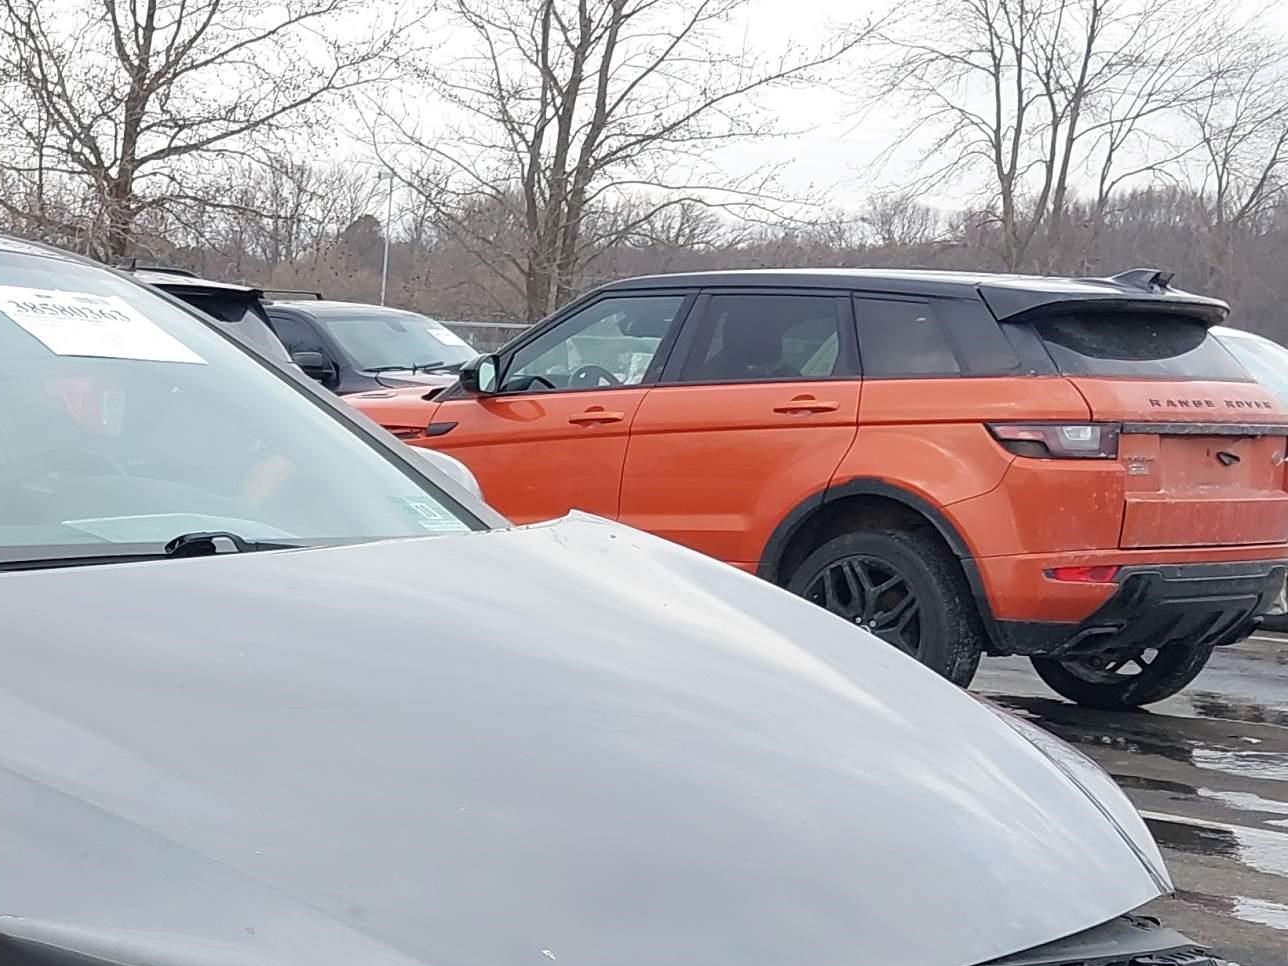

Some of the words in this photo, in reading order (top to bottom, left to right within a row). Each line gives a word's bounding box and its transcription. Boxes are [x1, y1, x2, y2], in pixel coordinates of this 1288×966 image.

[7, 299, 132, 322] 38580363
[1148, 398, 1216, 409] RANGE
[1224, 399, 1273, 410] ROVER
